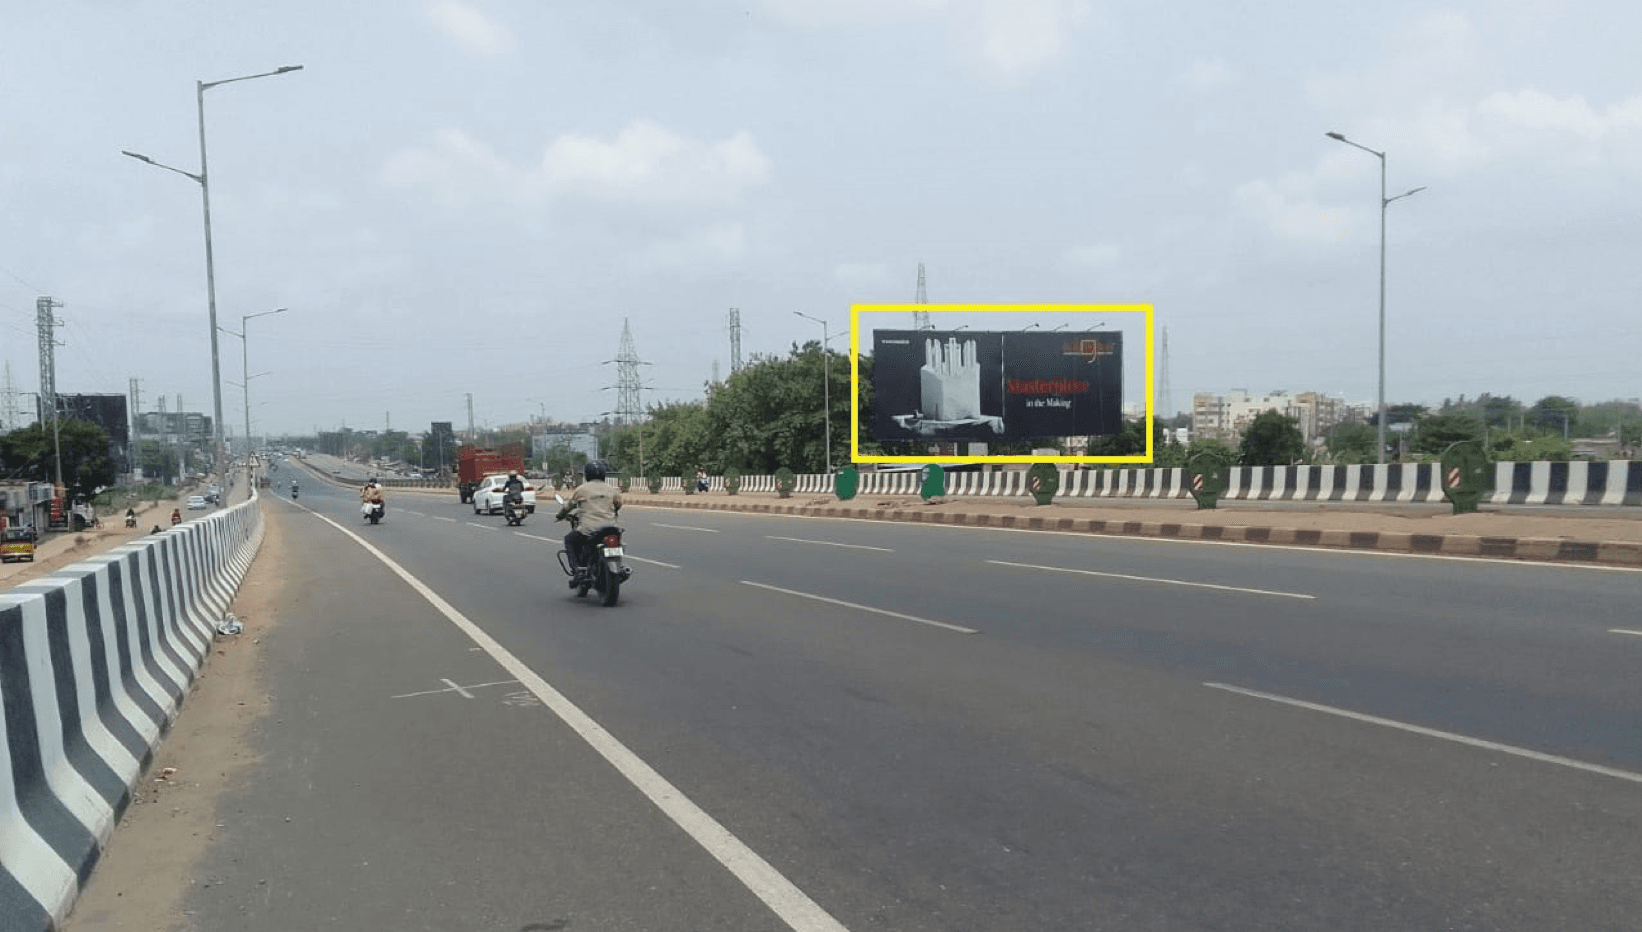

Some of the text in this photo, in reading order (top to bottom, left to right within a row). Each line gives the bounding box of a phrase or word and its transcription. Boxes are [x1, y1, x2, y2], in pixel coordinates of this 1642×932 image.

[1026, 398, 1072, 410] in the Making
